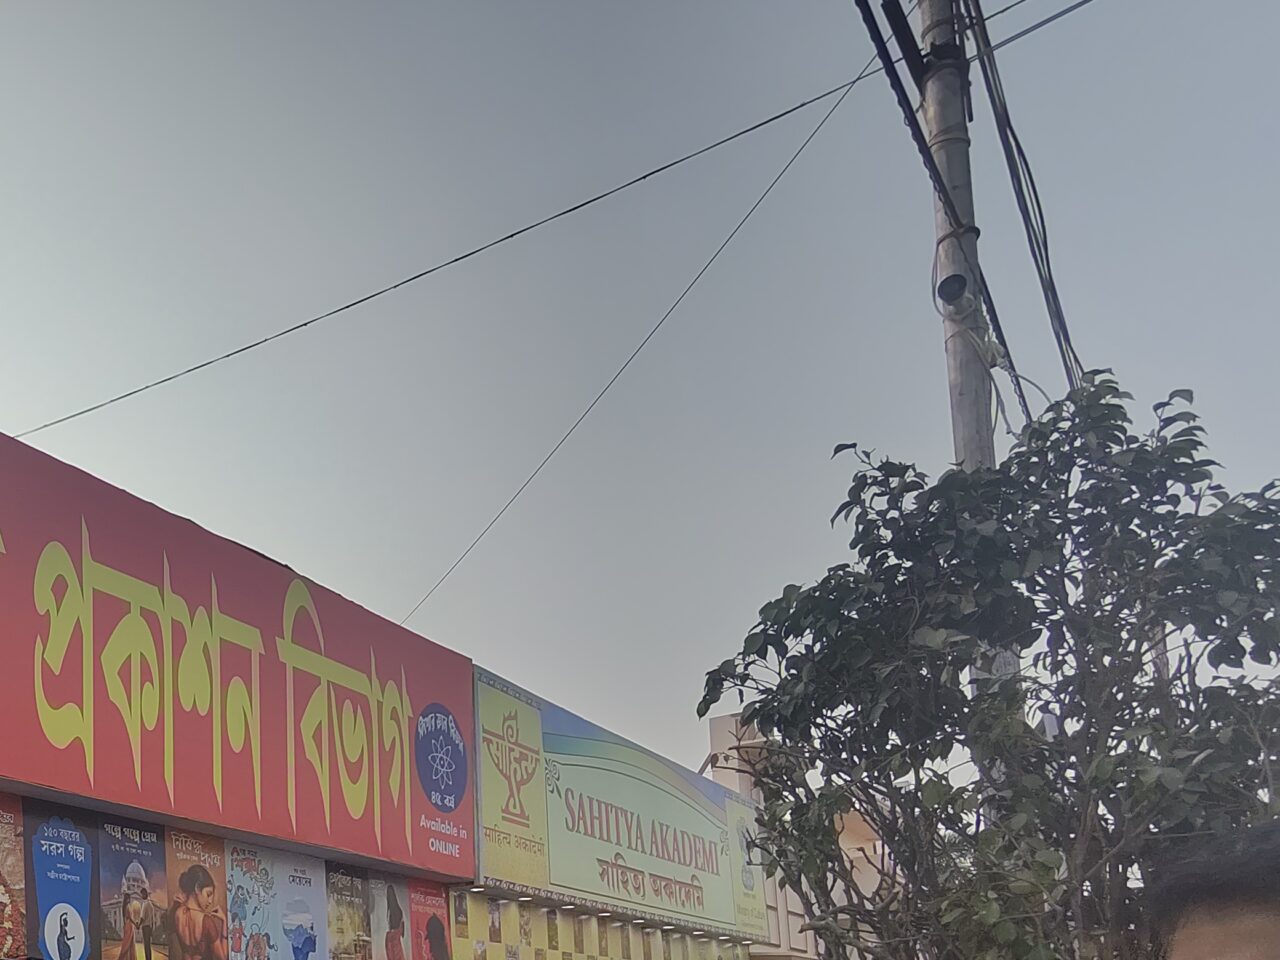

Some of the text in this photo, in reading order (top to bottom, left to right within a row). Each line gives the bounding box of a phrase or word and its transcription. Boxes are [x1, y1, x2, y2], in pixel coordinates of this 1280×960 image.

[33, 514, 265, 820] প্রকাশন
[275, 578, 413, 856] বিভাগ
[141, 831, 157, 843] প্রেম
[420, 814, 467, 839] Available in
[564, 787, 721, 877] SAHITYA AKADEMI
[40, 840, 85, 863] সরস গল্প
[429, 837, 460, 858] ONLINE
[596, 852, 646, 901] সাহিত্য
